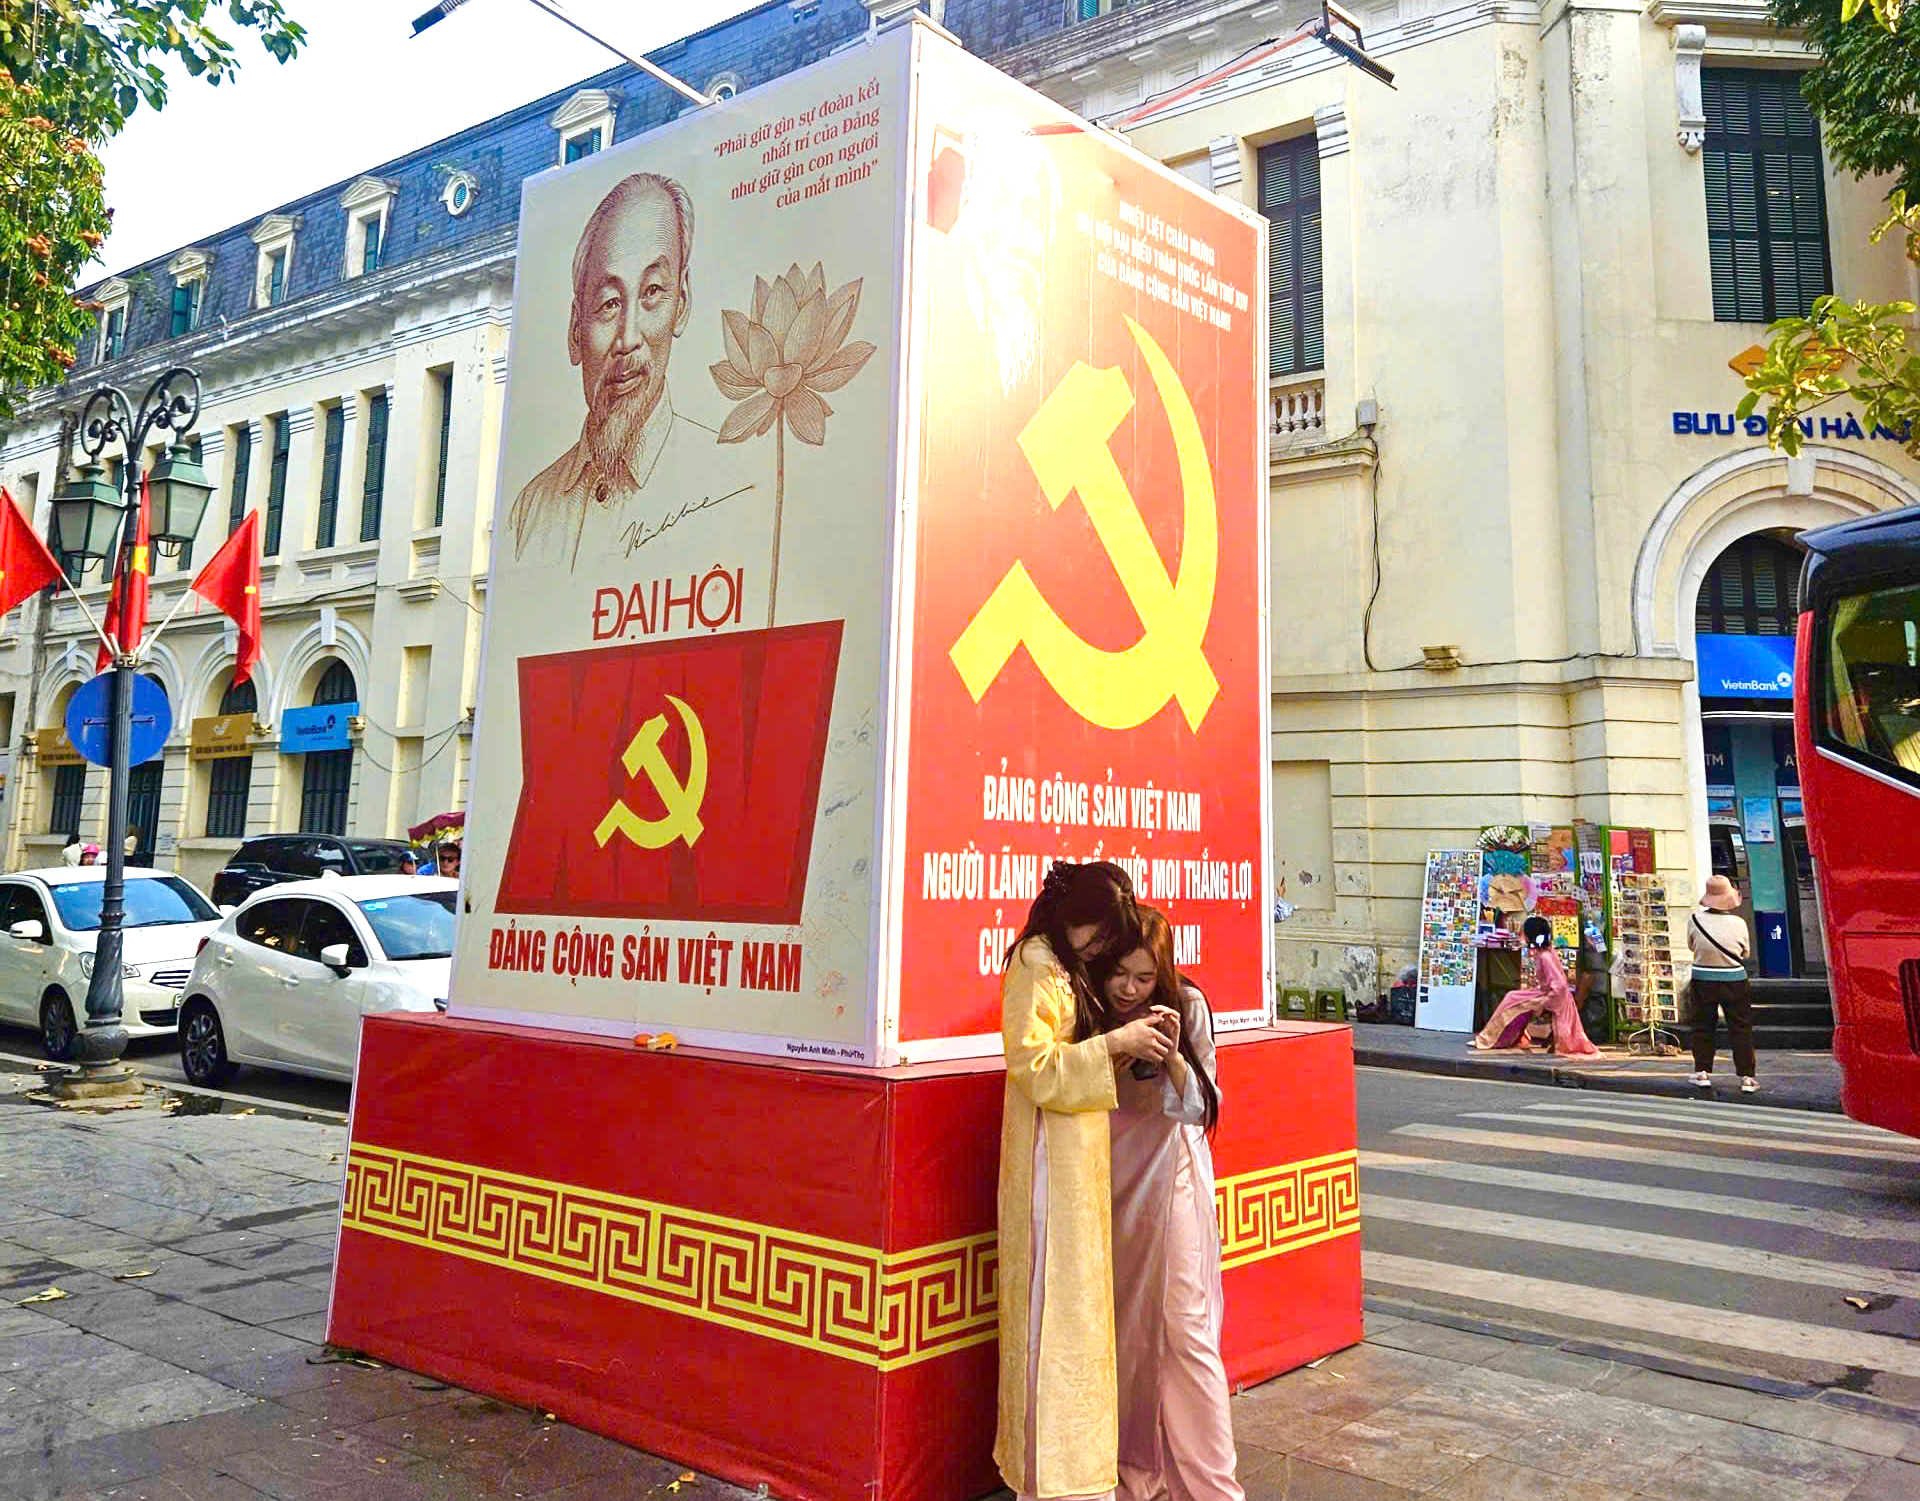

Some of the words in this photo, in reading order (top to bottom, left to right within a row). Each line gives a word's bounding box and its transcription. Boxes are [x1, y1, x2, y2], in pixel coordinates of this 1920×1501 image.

[714, 133, 747, 157] “Phải
[751, 123, 771, 148] giữ
[774, 117, 794, 140] gìn
[799, 107, 816, 126] sự
[819, 93, 853, 118] đoàn
[858, 77, 881, 103] kết
[762, 137, 791, 164] nhất
[795, 131, 809, 152] trí
[813, 124, 838, 145] của
[842, 107, 880, 134] Đảng
[731, 178, 756, 200] như
[759, 169, 780, 193] giữ
[783, 162, 804, 184] gìn
[808, 152, 833, 172] con
[776, 187, 800, 208] của
[804, 173, 831, 199] mắt
[835, 158, 878, 188] mình”
[1119, 200, 1145, 231] NHIỆT
[1146, 214, 1164, 241] LIỆT
[1166, 224, 1189, 252] CHÀO
[1190, 234, 1215, 267] MỪNG
[1098, 248, 1117, 278] CỦA
[1119, 257, 1144, 291] ĐẢNG
[1146, 275, 1170, 301] CỘNG
[1171, 282, 1189, 312] SẢN
[1191, 296, 1208, 322] VIỆT
[1209, 307, 1231, 332] NAM!
[1114, 228, 1130, 255] ĐẠI
[1131, 235, 1151, 265] BIỂU
[1154, 247, 1176, 276] TOÀN
[1178, 262, 1200, 288] QUỐC
[1218, 282, 1235, 305] THỨ
[1235, 291, 1248, 312] XIV
[1743, 414, 1813, 439] ĐN
[1820, 411, 1865, 440] HÀ
[592, 580, 658, 641] ĐẠI
[663, 563, 743, 632] HỘI
[1721, 679, 1778, 692] VietinBank
[1703, 753, 1724, 766] TM
[983, 757, 1035, 822] ĐẢNG
[1040, 772, 1089, 834] CỘNG
[1093, 768, 1127, 827] SẢN
[1131, 780, 1163, 838] VIỆT
[1167, 791, 1200, 832] NAM
[923, 841, 984, 900] NGƯỜI
[989, 846, 1037, 899] LÃNH
[1108, 846, 1148, 899] ỨC
[1152, 860, 1180, 908] MỌI
[1184, 848, 1228, 900] THẮNG
[1232, 860, 1252, 909] LỢI
[488, 918, 547, 973] ĐẢNG
[552, 924, 615, 986] CỘNG
[621, 924, 670, 982] SẢN
[677, 931, 733, 995] VIỆT
[740, 941, 802, 992] NAM
[1170, 925, 1201, 965] AM!
[822, 1047, 836, 1055] Minh
